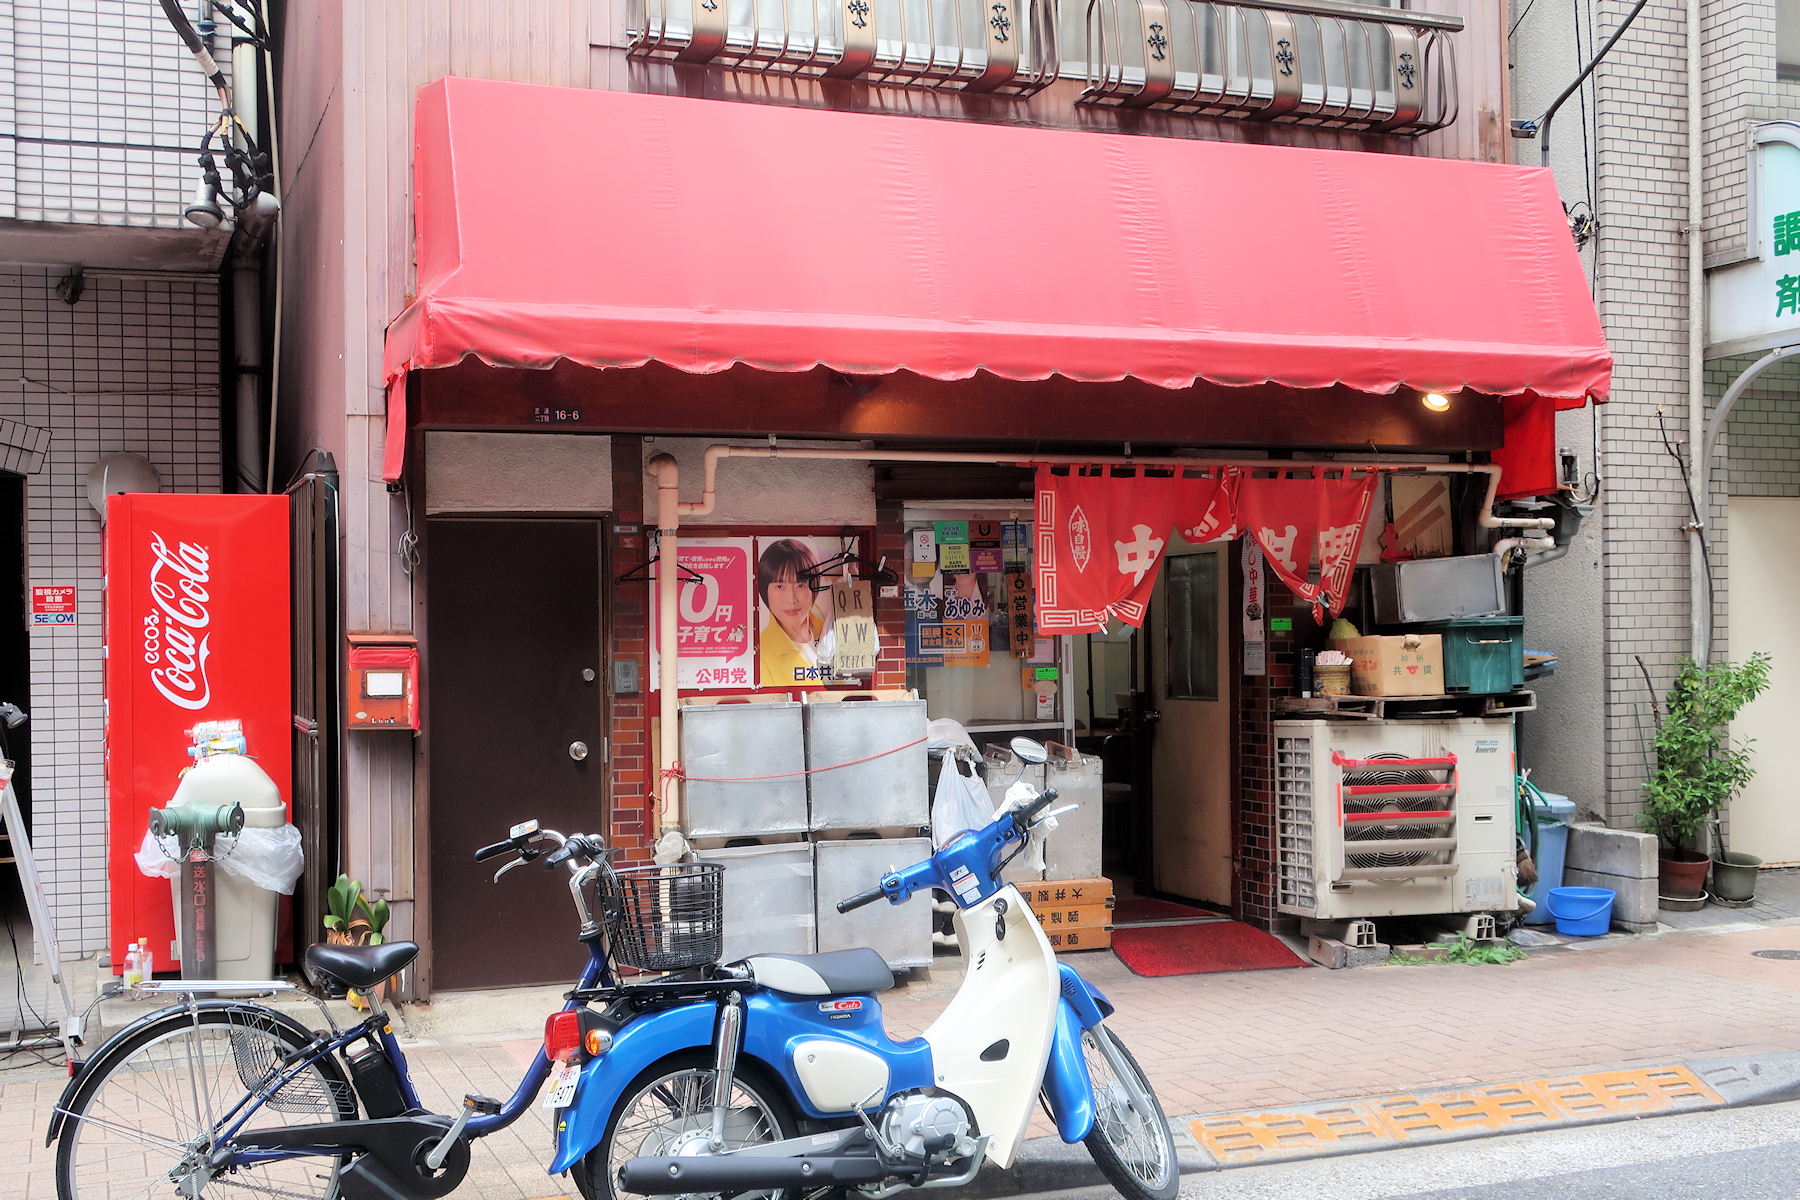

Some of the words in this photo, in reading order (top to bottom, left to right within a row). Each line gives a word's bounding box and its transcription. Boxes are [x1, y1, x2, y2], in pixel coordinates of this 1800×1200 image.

[555, 409, 580, 421] 16-6
[1071, 515, 1087, 560] 味自慢
[35, 588, 73, 596] 監視カメラ
[45, 595, 63, 603] 設置
[904, 590, 936, 610] 玉木
[945, 598, 986, 618] あゆみ
[34, 613, 74, 623] SECOM
[150, 530, 211, 710] Coca-Cola
[1013, 595, 1028, 646] 営業中
[677, 625, 727, 643] 子育て
[922, 627, 941, 638] 国民
[945, 627, 961, 636] こく
[945, 637, 962, 646] みん
[695, 667, 747, 684] 公明党
[793, 666, 836, 682] 日本共
[1475, 745, 1498, 754] Inverter
[1047, 932, 1079, 947] 製麺
[837, 1000, 858, 1009] Cub
